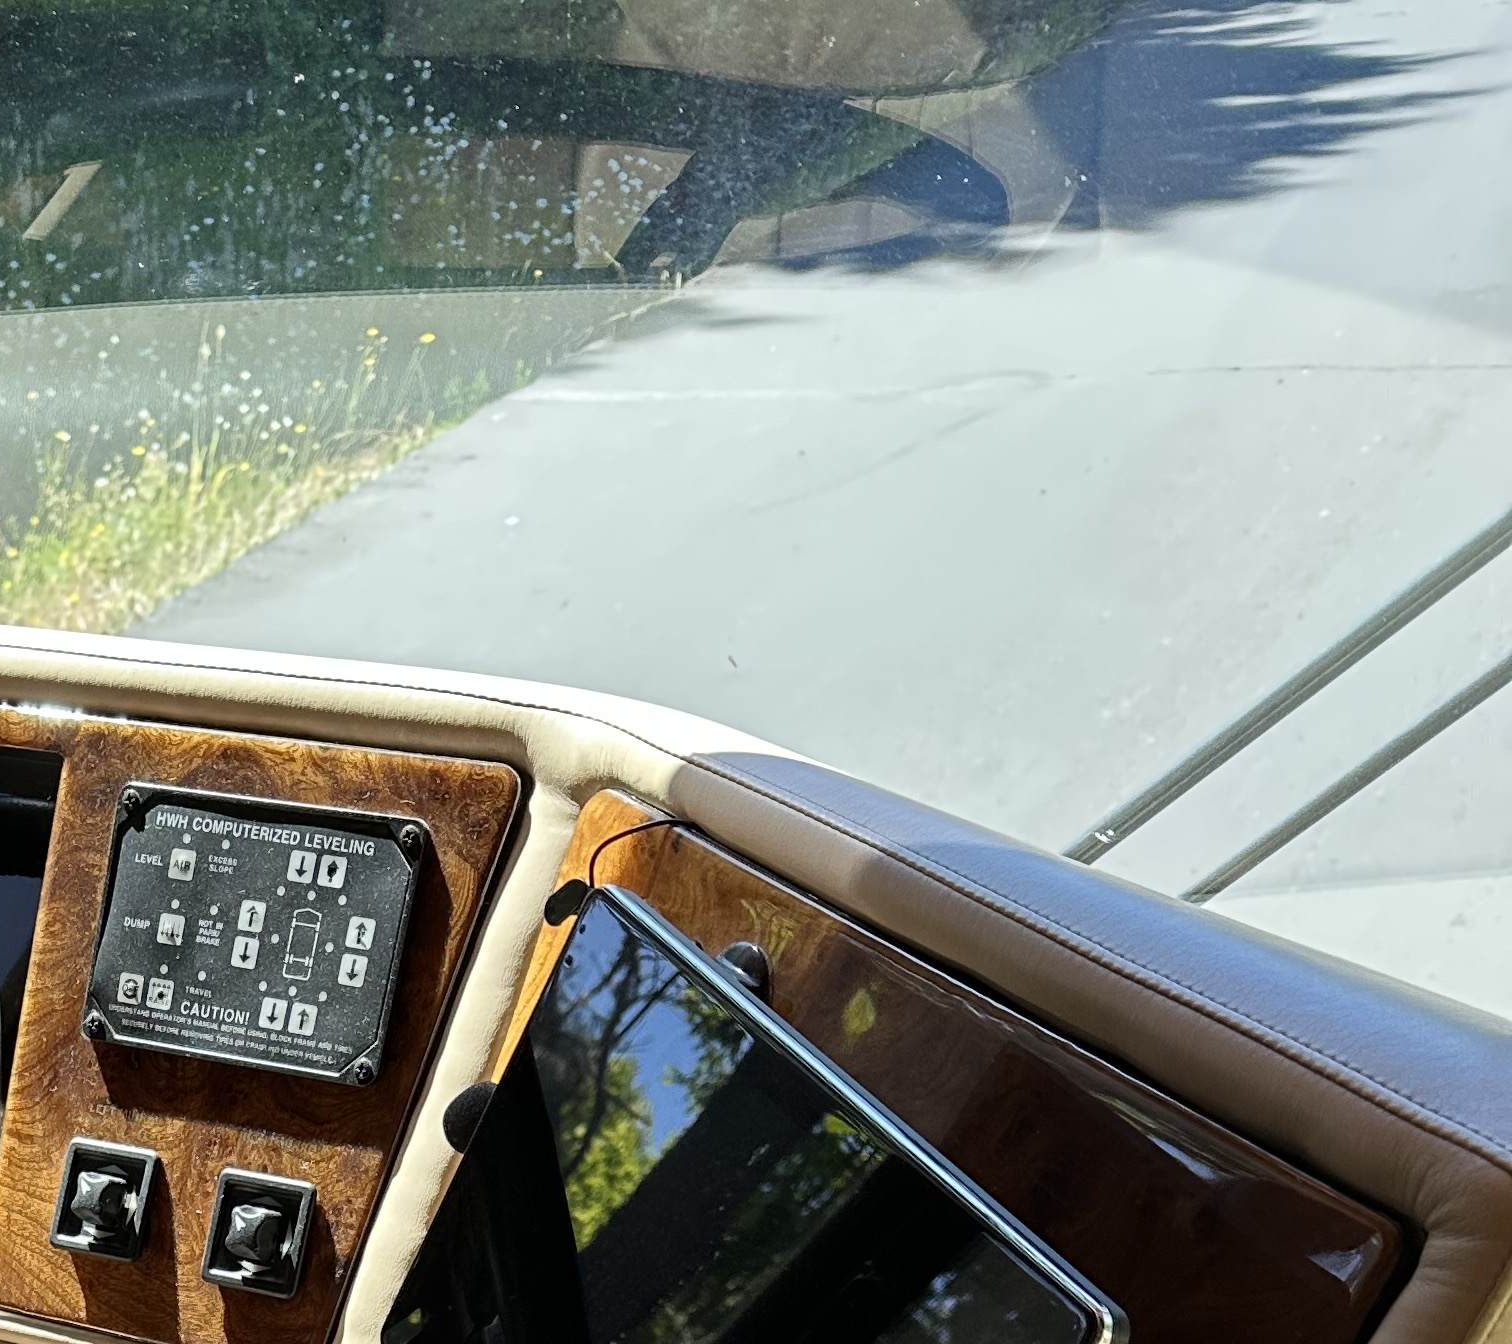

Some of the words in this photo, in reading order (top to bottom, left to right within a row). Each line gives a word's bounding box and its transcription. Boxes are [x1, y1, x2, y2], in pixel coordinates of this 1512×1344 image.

[155, 811, 189, 830] HWH
[192, 816, 301, 846] COMPUTERIZED
[304, 832, 375, 857] LEVELING
[134, 852, 164, 867] LEVEL
[208, 863, 235, 875] SLOPE
[123, 916, 151, 930] DUMP
[185, 985, 212, 999] TRAVEL
[180, 1000, 250, 1026] CAUTION!
